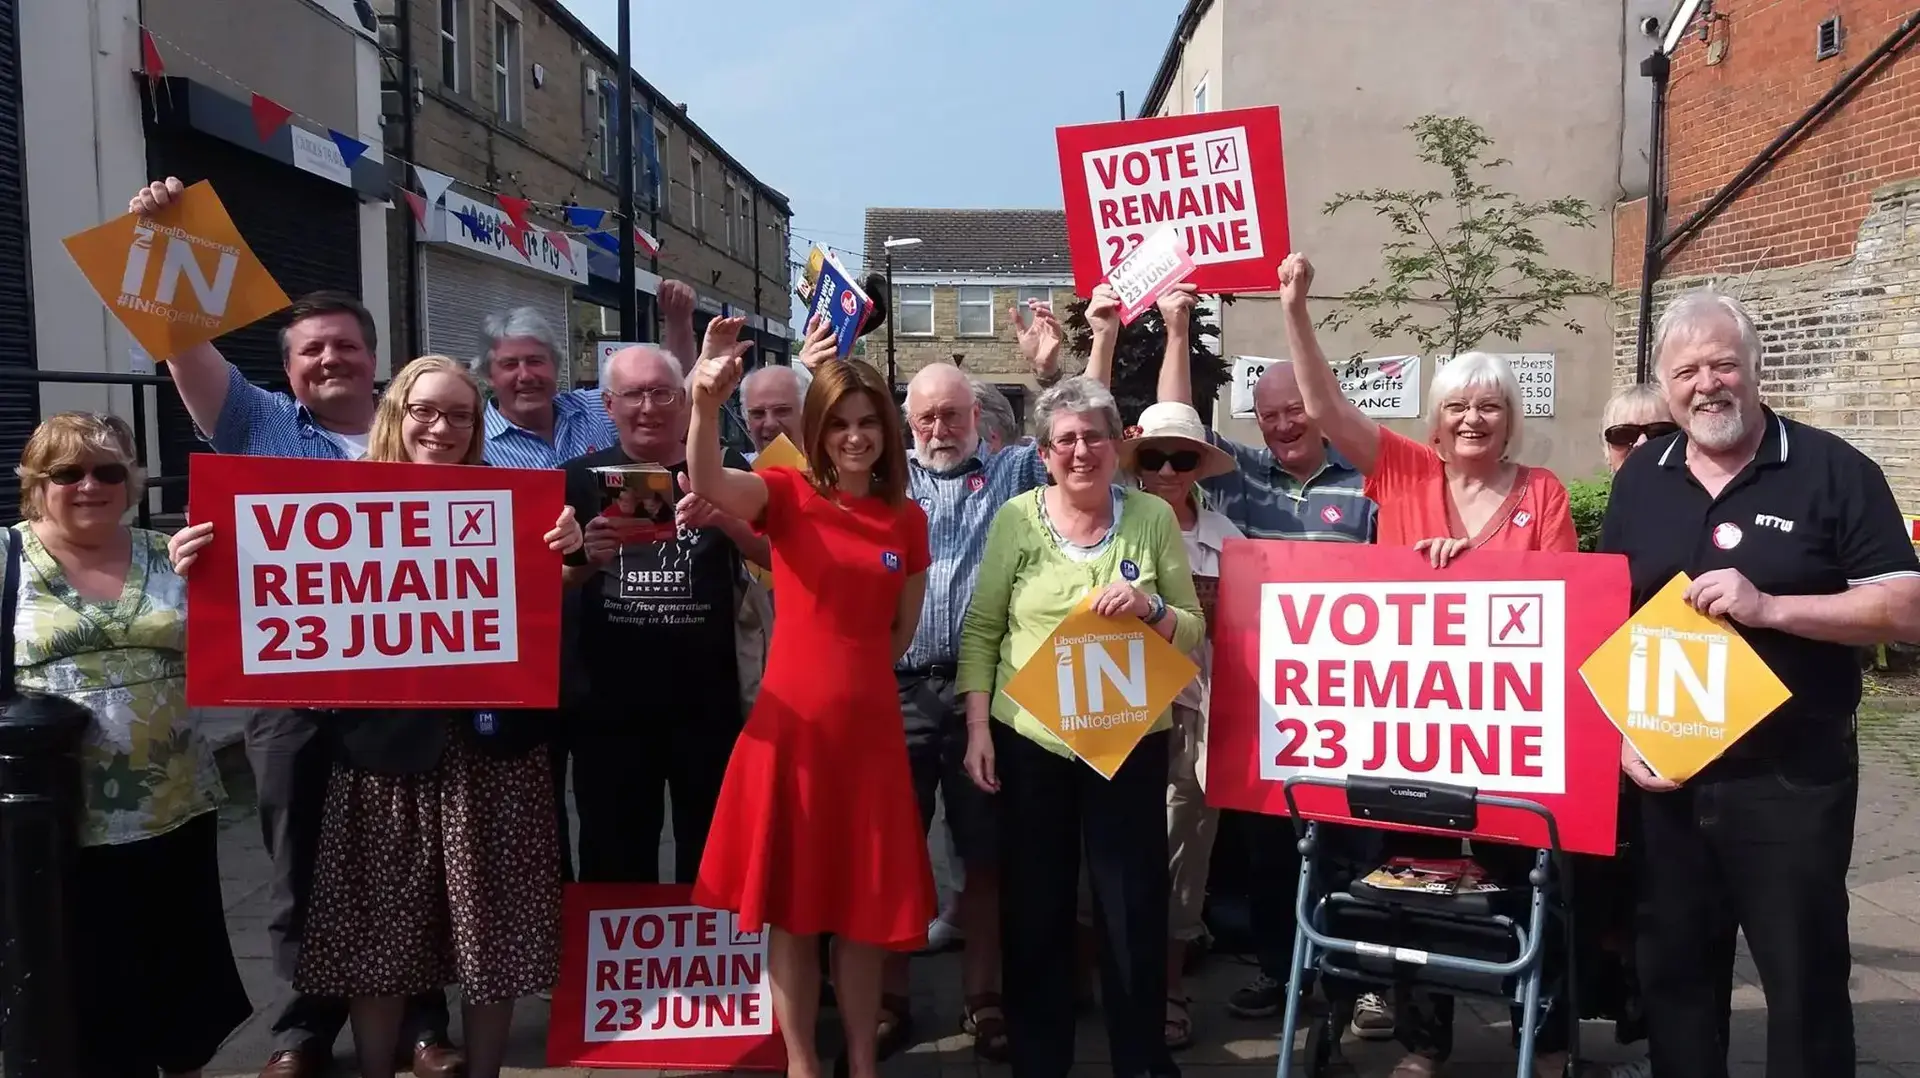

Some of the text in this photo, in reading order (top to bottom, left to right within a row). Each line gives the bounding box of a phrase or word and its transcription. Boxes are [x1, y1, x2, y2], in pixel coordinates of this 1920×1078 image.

[1092, 142, 1198, 190] VOTE
[1099, 180, 1245, 229] REMAIN
[821, 274, 832, 297] WHO
[1124, 284, 1143, 303] 23
[1139, 255, 1176, 289] JUNE
[1373, 379, 1403, 391] Gifts
[1519, 372, 1552, 383] £4.50
[1523, 403, 1551, 414] 3.50
[607, 474, 622, 486] IN
[251, 501, 431, 551] VOTE
[1755, 514, 1794, 533] RTTW
[253, 557, 498, 607] REMAIN
[627, 571, 686, 584] SHEEP
[603, 600, 712, 614] Born of five generations
[648, 615, 659, 624] in
[660, 614, 706, 624] Masham
[1278, 593, 1466, 645] VOTE
[256, 609, 501, 661] 23 JUNE
[1274, 659, 1543, 712] REMAIN
[1061, 709, 1150, 731] #INtogether
[1627, 712, 1726, 739] #INtogether
[1274, 718, 1543, 777] 23 JUNE
[600, 912, 717, 951] VOTE
[596, 953, 761, 992] REMAIN
[594, 992, 760, 1032] 23 JUNE
